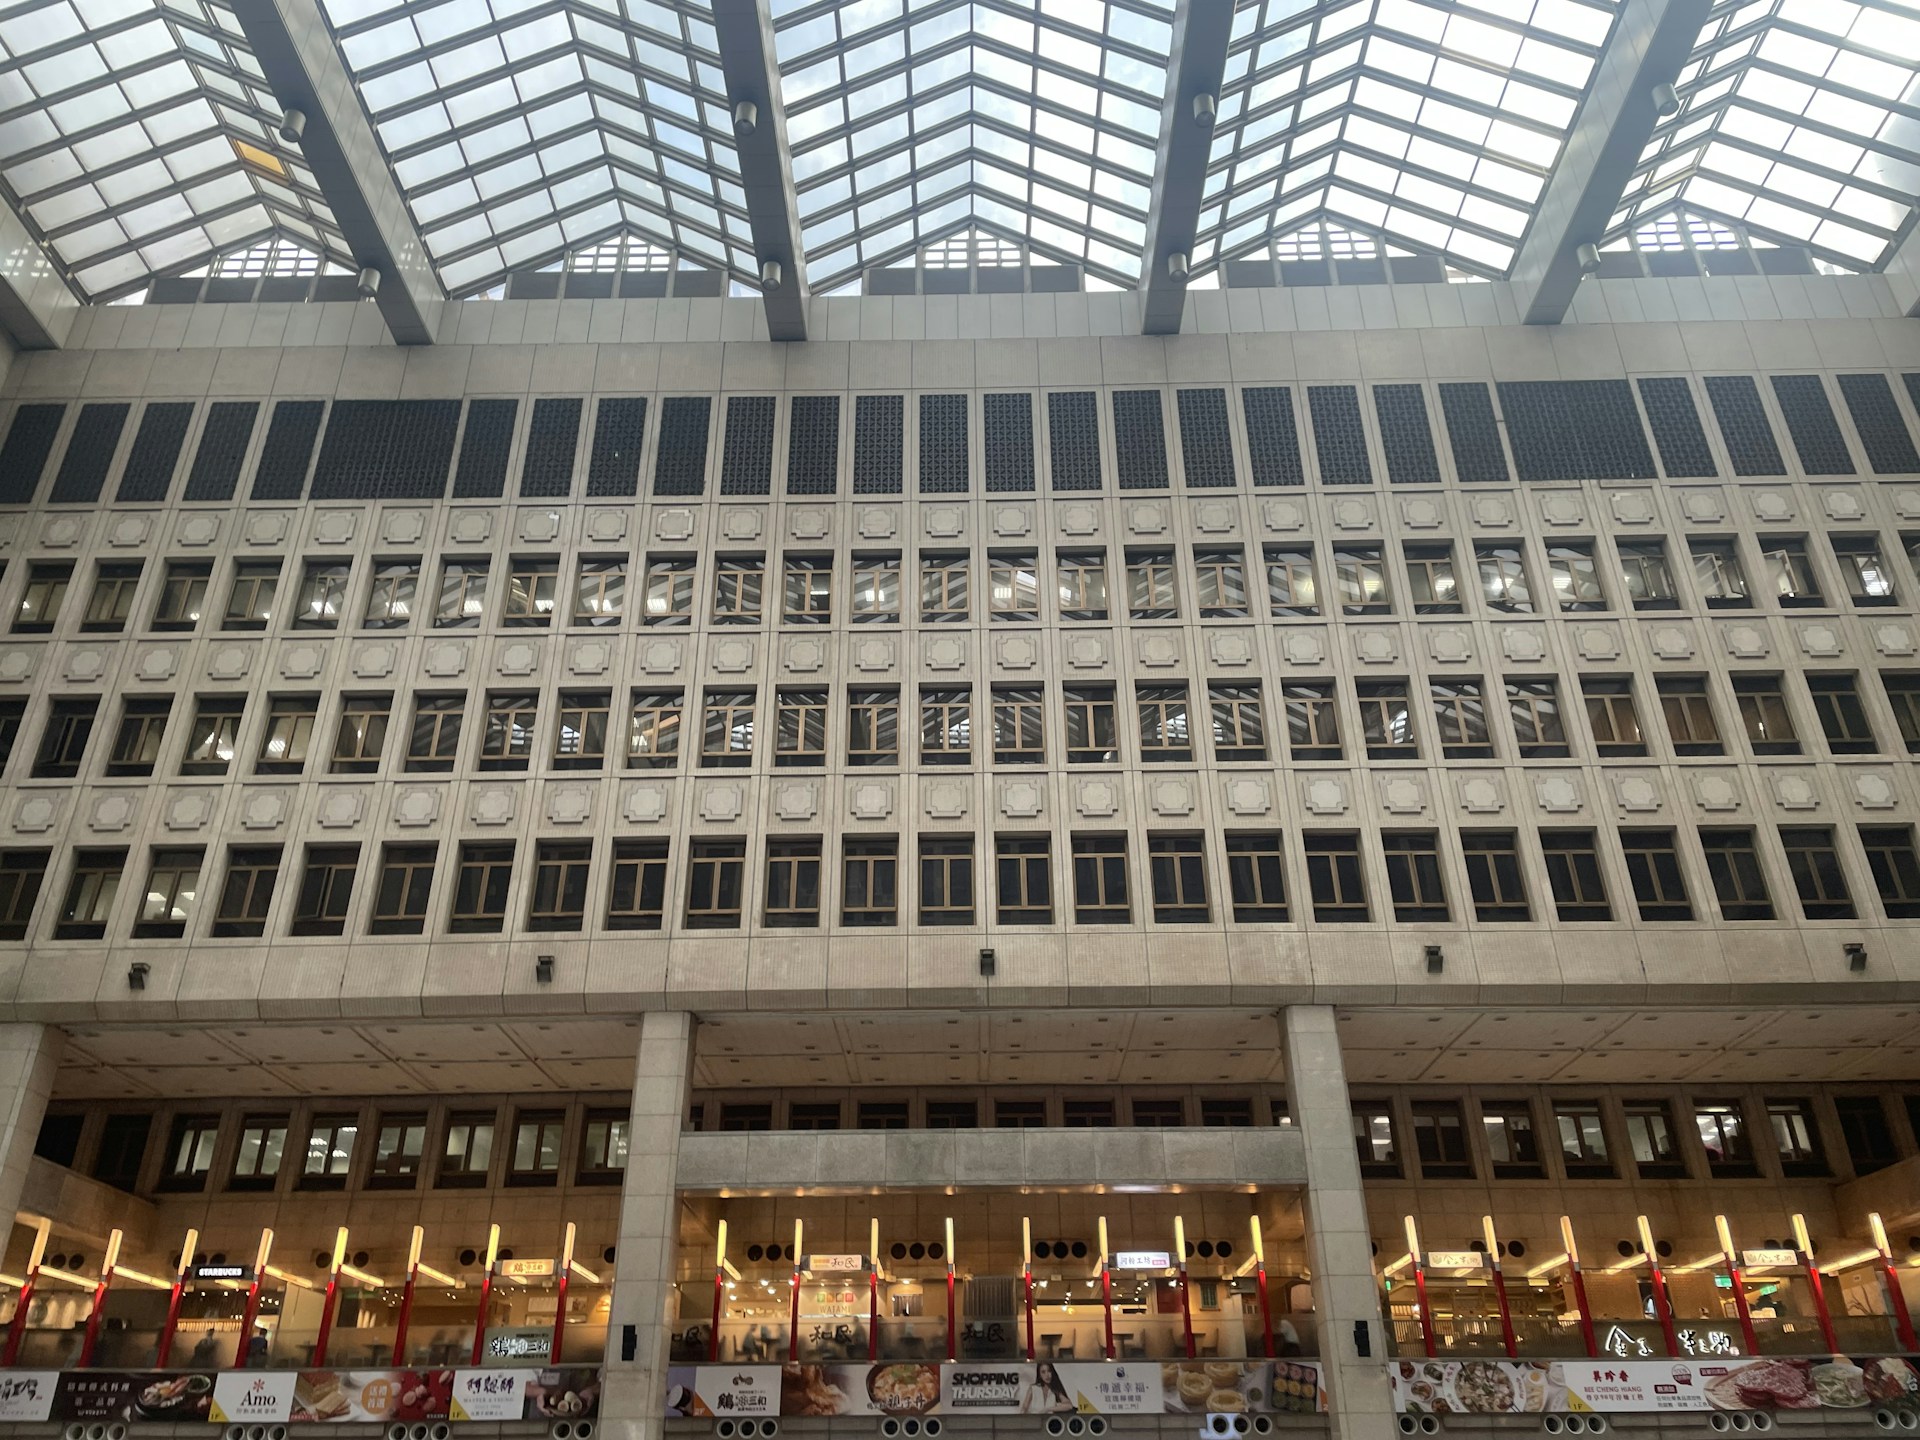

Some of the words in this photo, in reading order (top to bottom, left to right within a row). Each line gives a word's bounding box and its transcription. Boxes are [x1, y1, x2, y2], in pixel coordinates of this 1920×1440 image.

[831, 1257, 856, 1269] 和民
[199, 1268, 242, 1276] STARBUCKS
[820, 1305, 851, 1314] WATAMI
[809, 1324, 852, 1345] 和民
[952, 1373, 1019, 1385] SHOPPING
[240, 1390, 277, 1406] Amo
[952, 1386, 1019, 1399] THURSDAY
